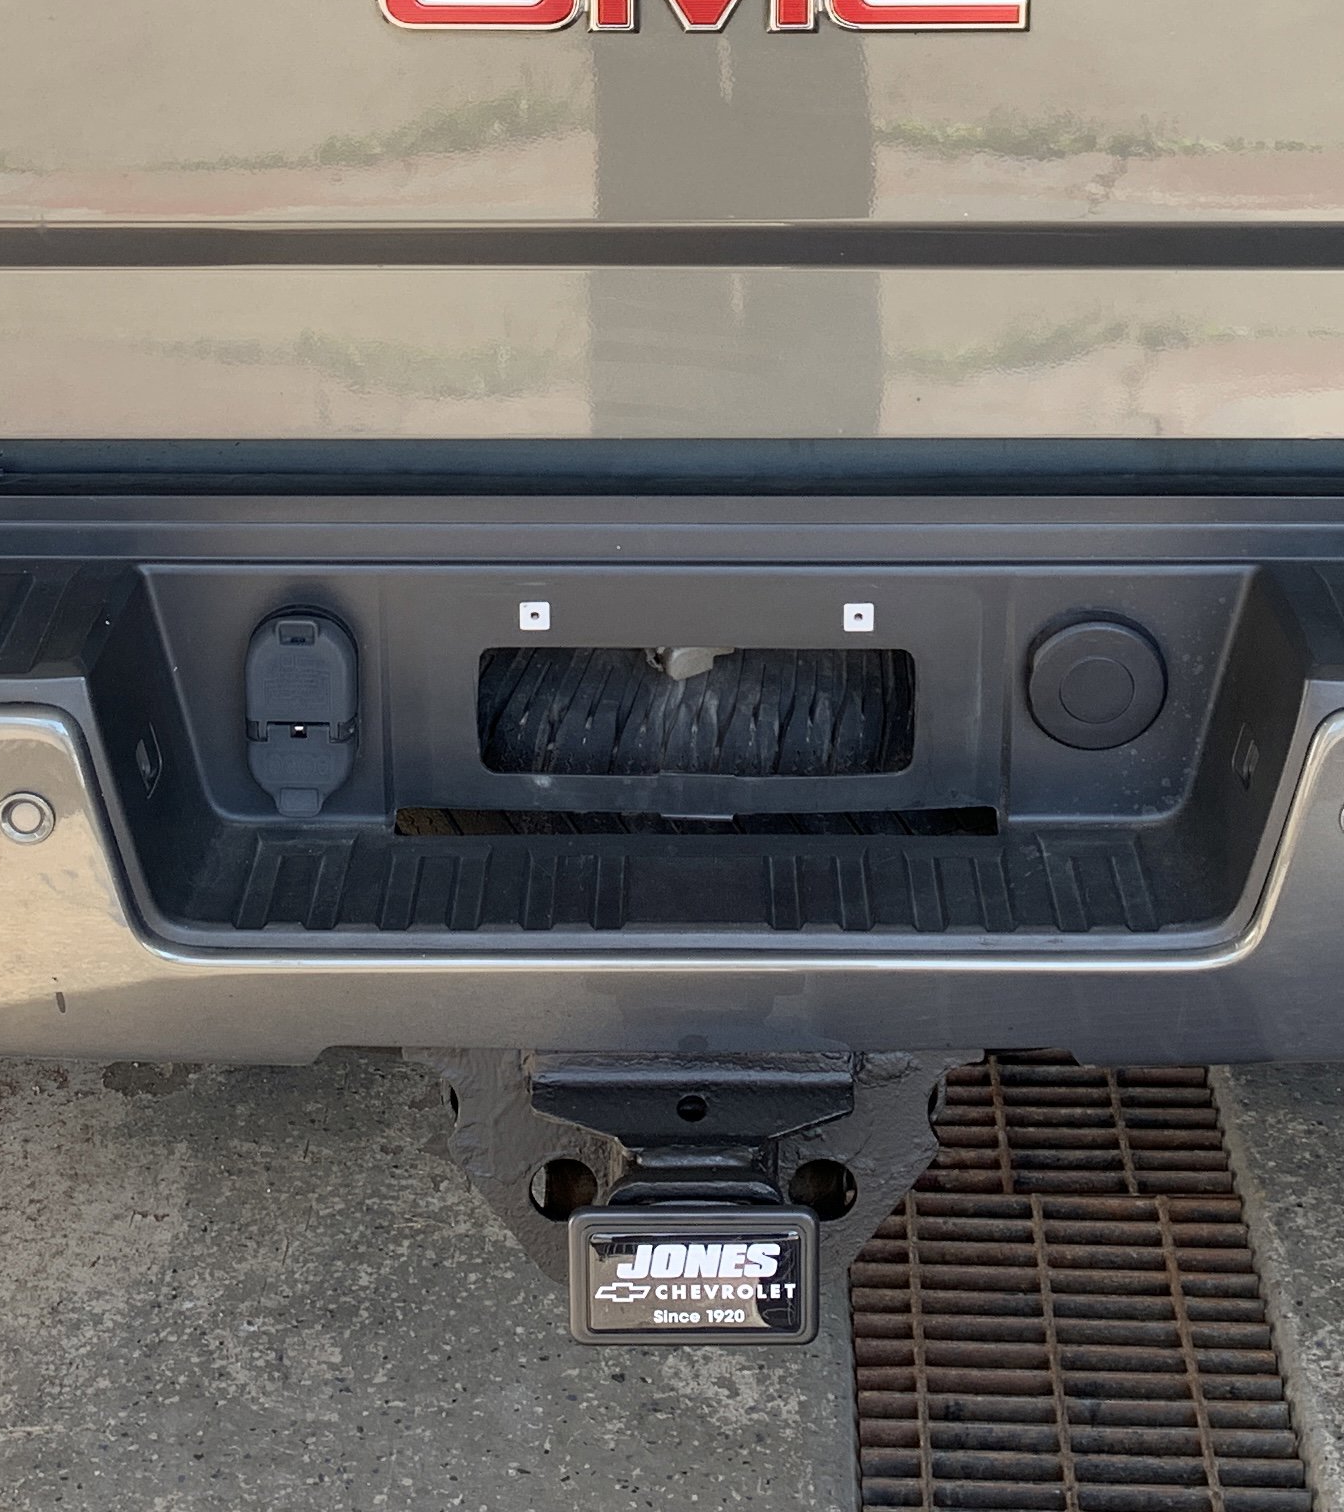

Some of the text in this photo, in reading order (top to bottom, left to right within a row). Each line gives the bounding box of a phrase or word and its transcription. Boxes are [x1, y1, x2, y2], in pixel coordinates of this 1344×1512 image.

[616, 1243, 781, 1279] JONES
[655, 1283, 797, 1300] CHEVROLET
[653, 1308, 746, 1324] Since 1920
